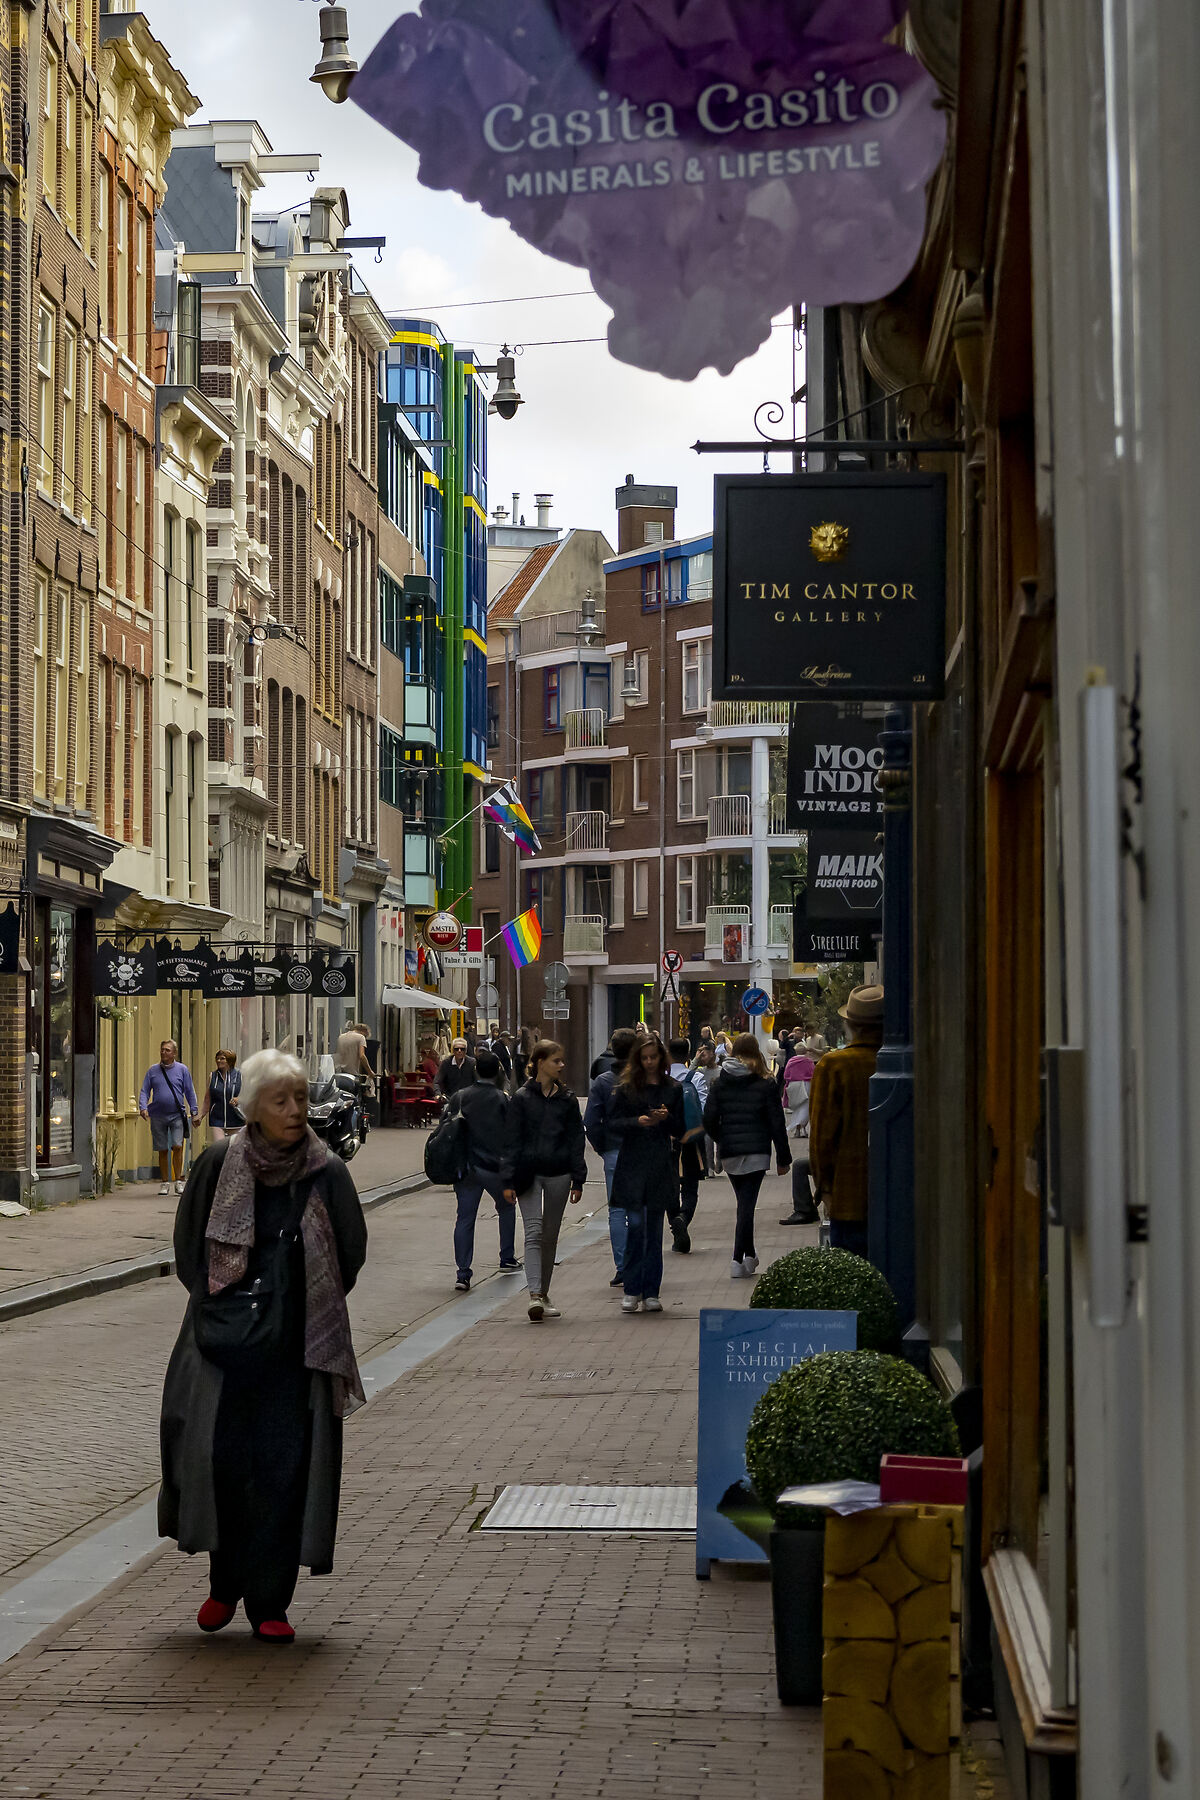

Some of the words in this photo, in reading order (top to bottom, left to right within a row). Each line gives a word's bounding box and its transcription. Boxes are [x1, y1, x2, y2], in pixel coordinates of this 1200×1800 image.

[482, 90, 676, 153] Casita
[698, 71, 900, 135] Casito
[505, 159, 671, 198] MINERALS
[685, 158, 704, 183] &
[719, 141, 882, 181] LIFESTYLE
[740, 583, 790, 600] TIM
[804, 583, 917, 601] CANTOR
[774, 611, 883, 623] GALLERY
[814, 745, 884, 770] MOO
[804, 770, 884, 794] INDI
[797, 800, 871, 813] VINTAGE
[817, 855, 883, 877] MAIK
[814, 878, 849, 888] FUSION
[851, 878, 878, 888] FOOD
[810, 934, 860, 951] STREETLIFE
[726, 1355, 804, 1367] EXHIBIT
[725, 1371, 756, 1383] TIM
